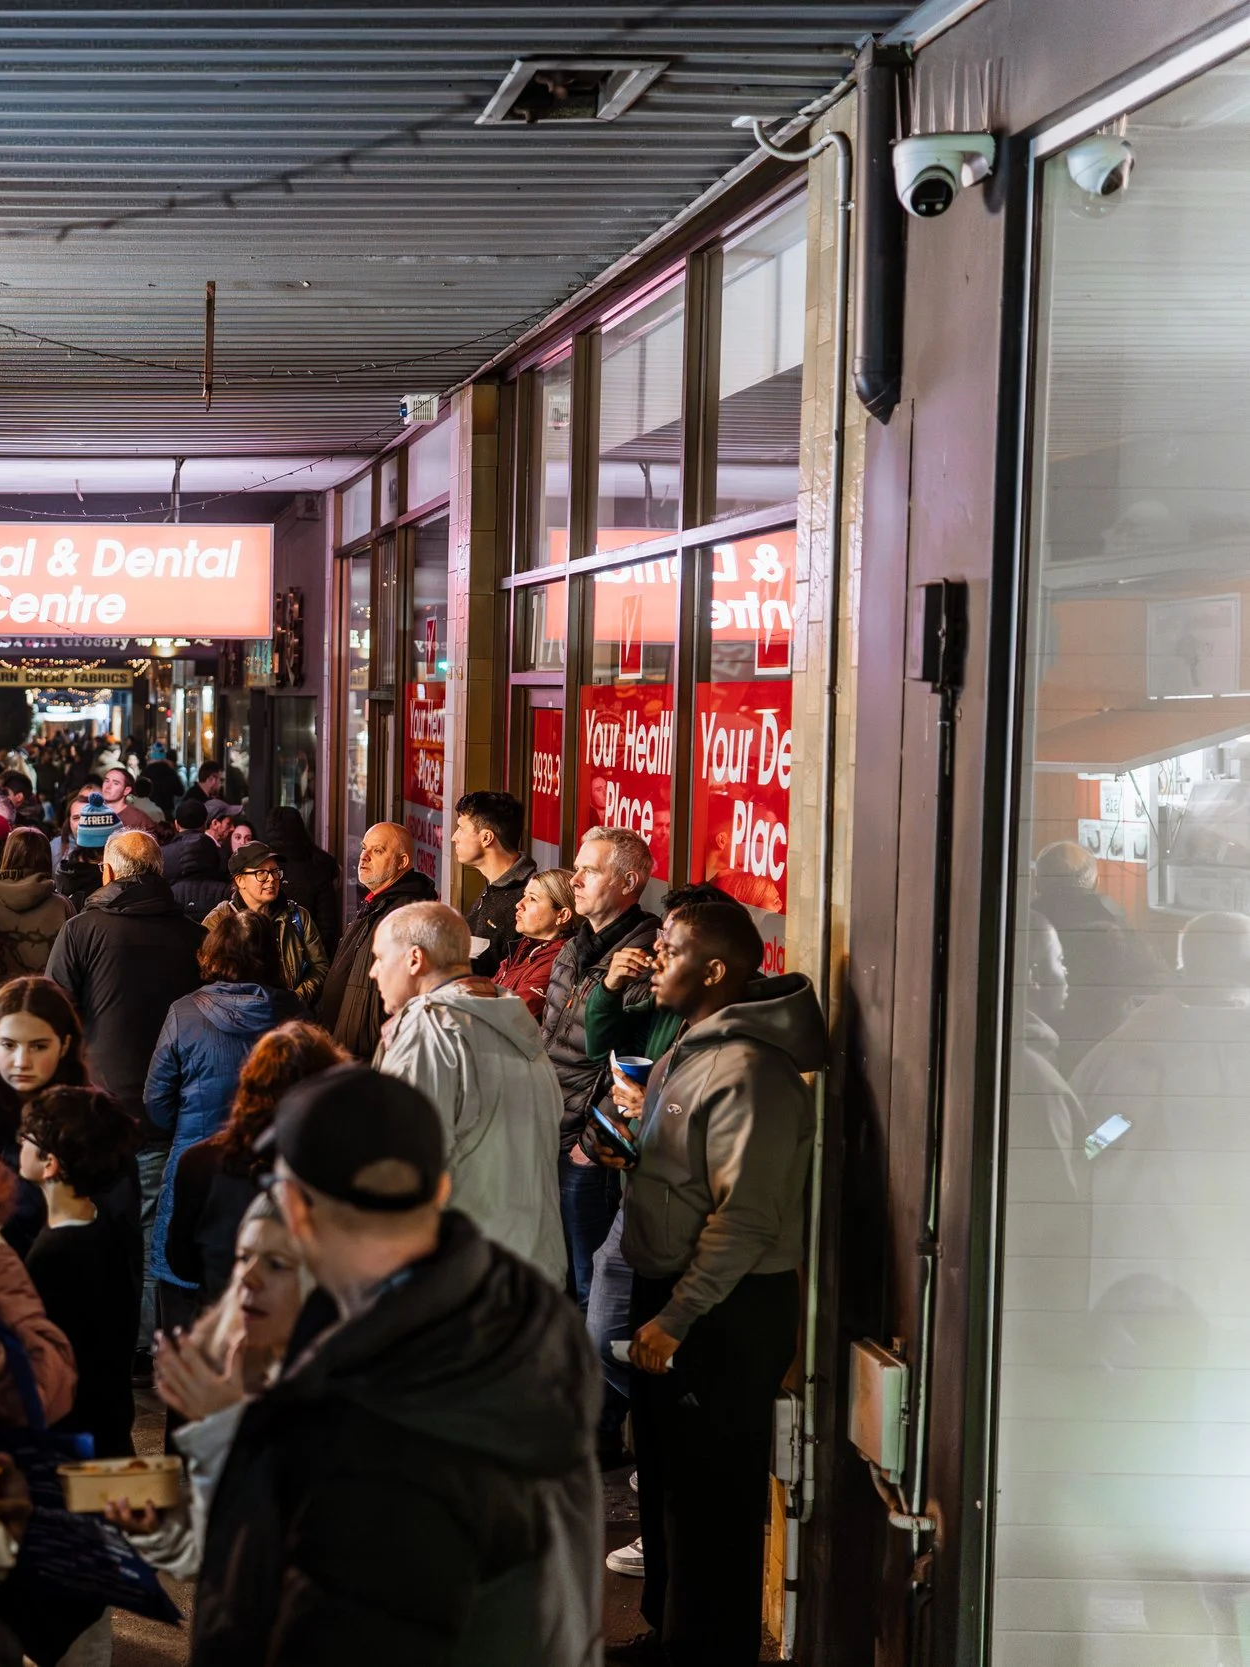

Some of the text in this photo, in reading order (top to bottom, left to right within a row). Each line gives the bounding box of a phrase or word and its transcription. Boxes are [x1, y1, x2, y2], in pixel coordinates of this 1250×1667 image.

[46, 538, 80, 577] &
[91, 539, 241, 578] Dental
[73, 671, 128, 684] FABRICS
[410, 699, 425, 740] Your
[585, 709, 621, 768] Your
[701, 712, 754, 784] Your
[418, 749, 440, 793] Place
[532, 751, 553, 795] 9939
[87, 815, 114, 825] FREEZE
